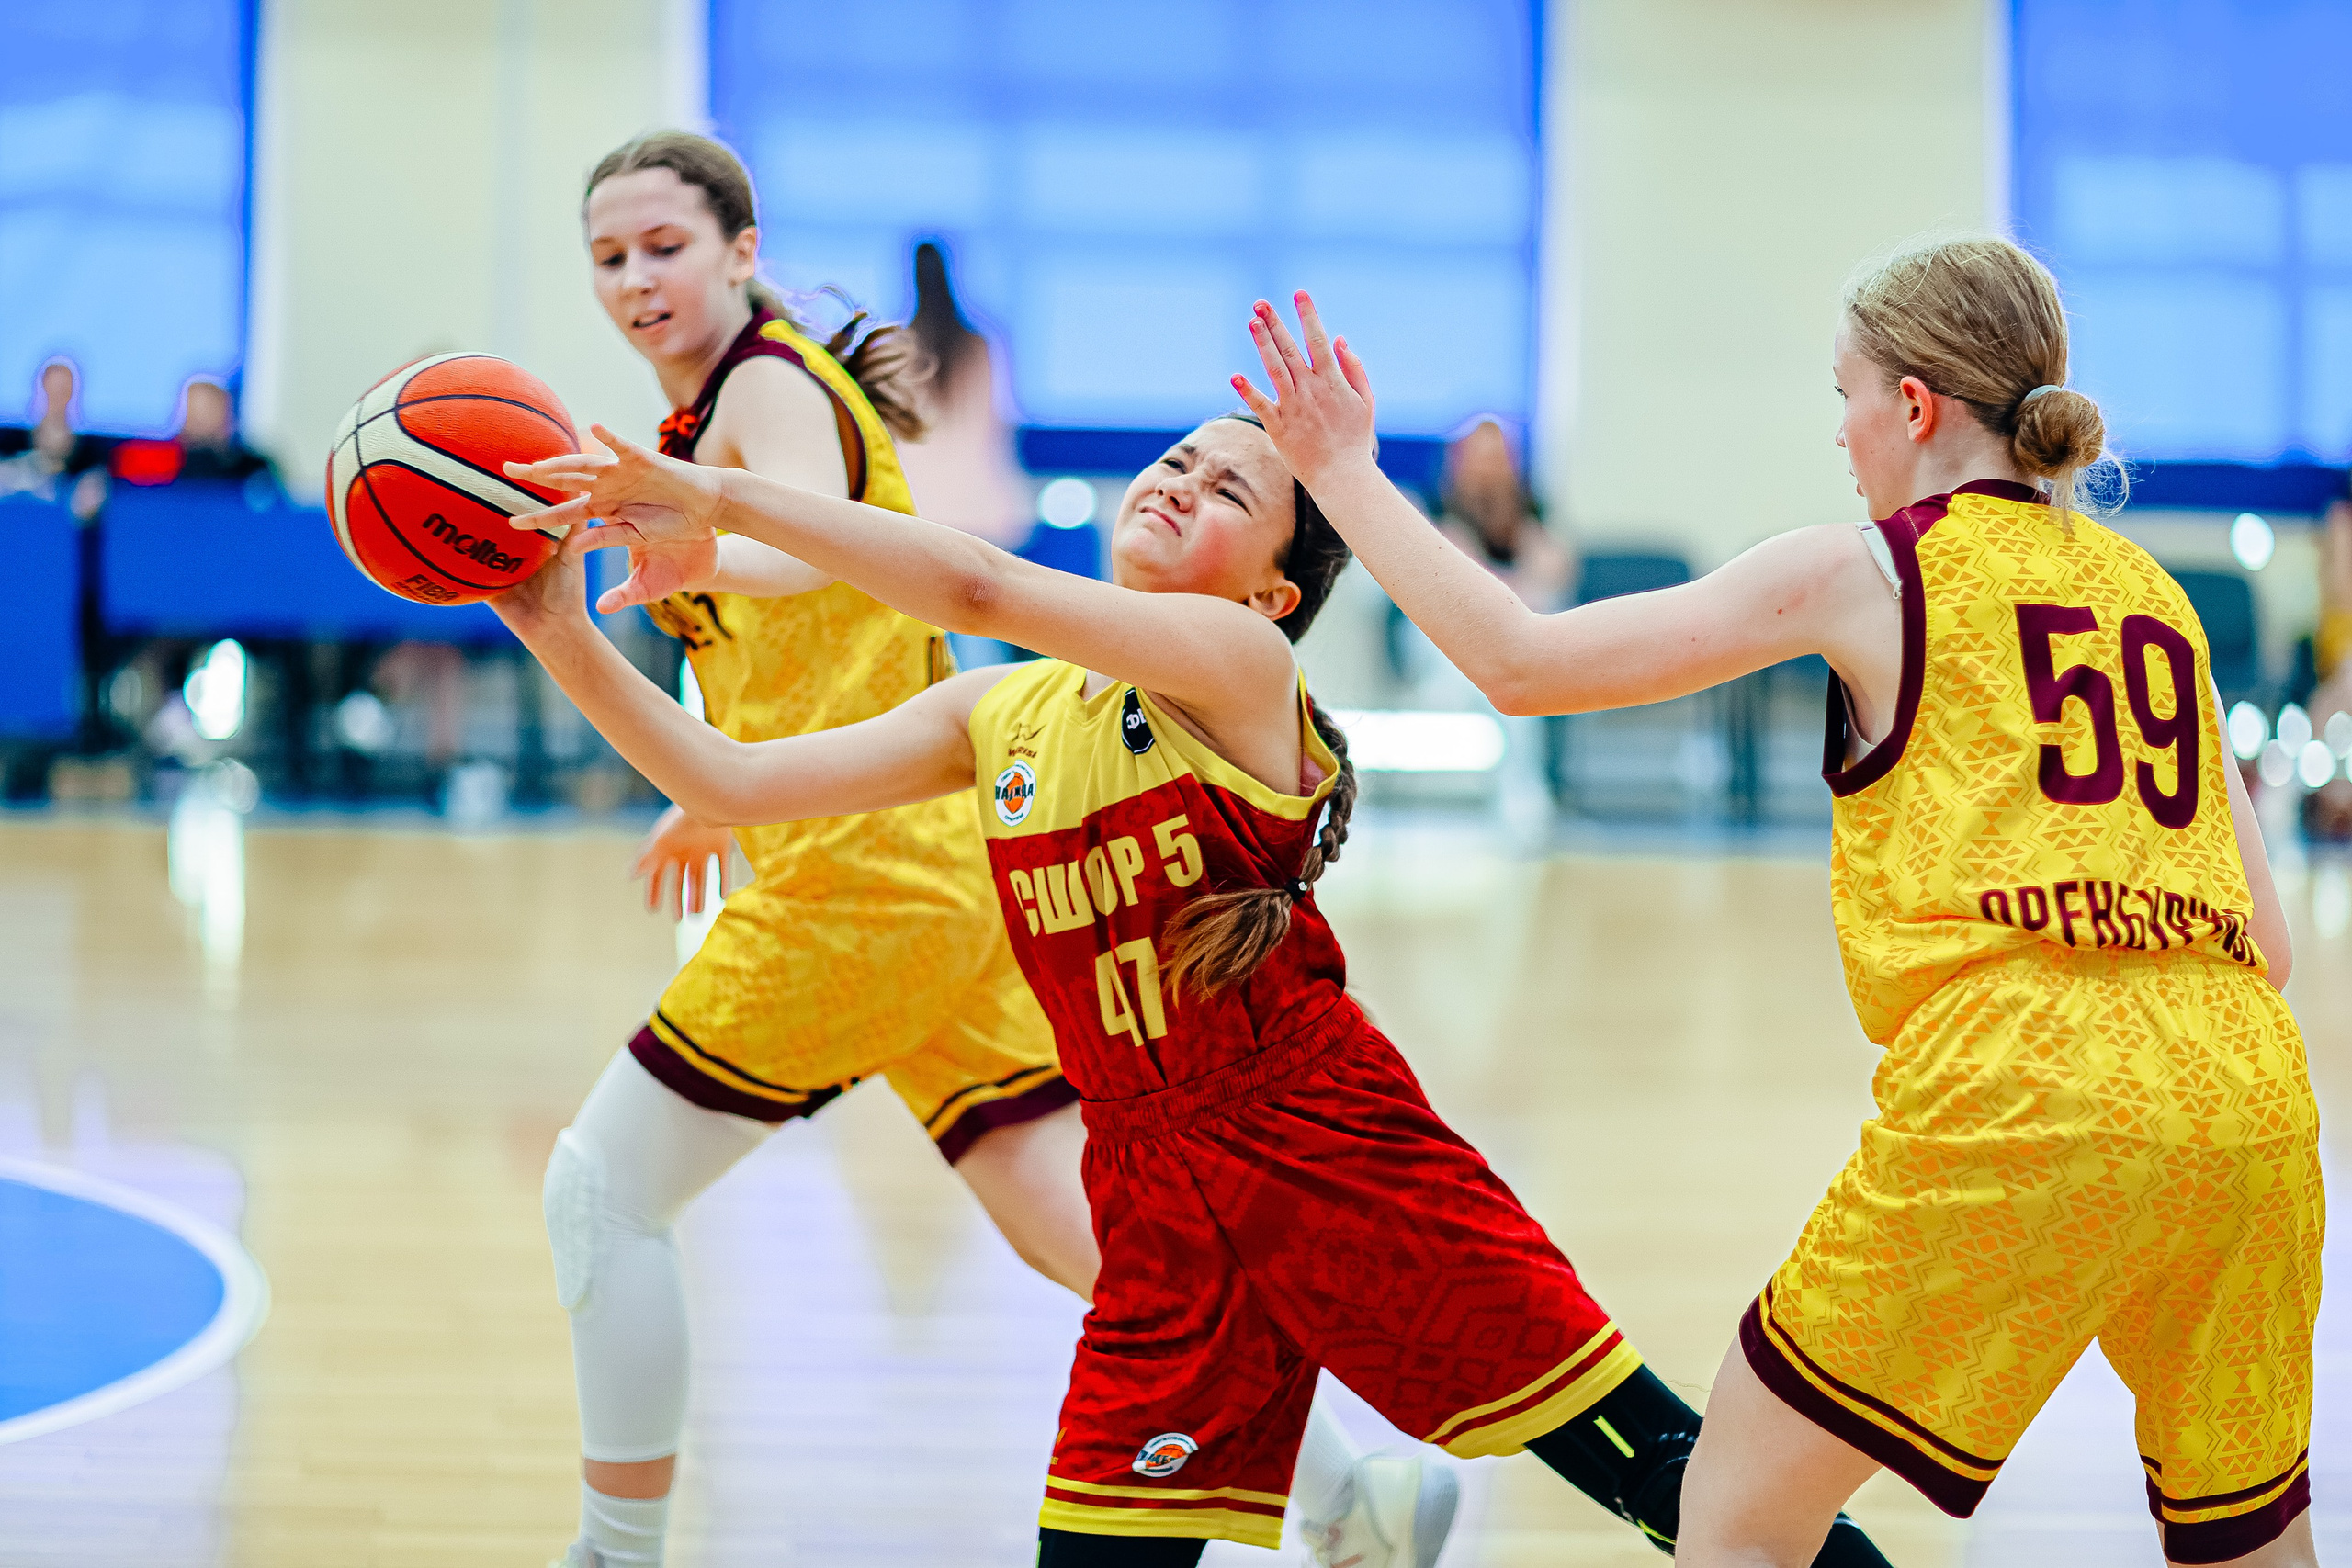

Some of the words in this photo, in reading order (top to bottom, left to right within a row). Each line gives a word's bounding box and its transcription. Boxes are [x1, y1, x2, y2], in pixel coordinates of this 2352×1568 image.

[422, 513, 525, 574] molten
[2013, 604, 2199, 830] 59
[1009, 835, 1146, 938] СШОР
[1151, 814, 1204, 888] 5
[1094, 936, 1168, 1048] 47
